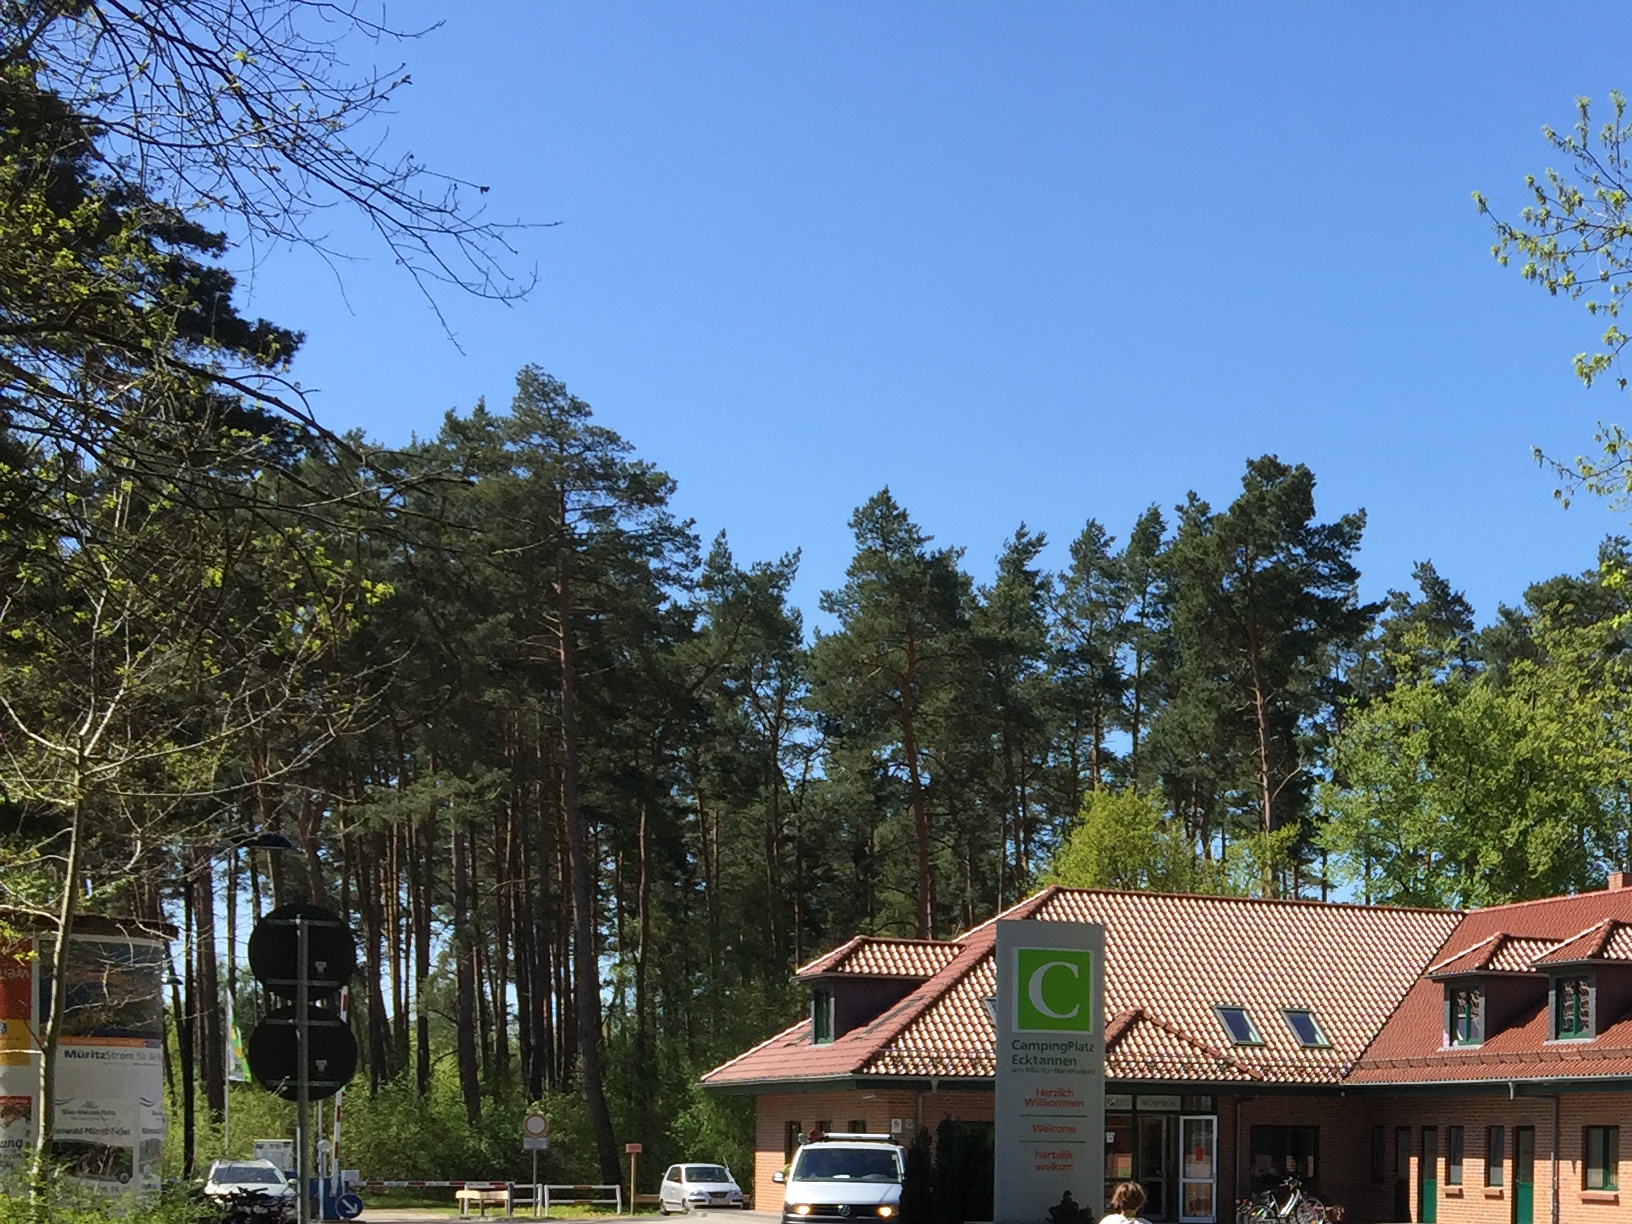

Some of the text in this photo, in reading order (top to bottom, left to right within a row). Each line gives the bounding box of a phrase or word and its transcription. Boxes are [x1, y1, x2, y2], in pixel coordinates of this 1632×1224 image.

[1027, 960, 1080, 1019] C
[1011, 1039, 1095, 1054] CampingPlatz
[64, 1049, 134, 1060] MüritzStrom
[1011, 1054, 1077, 1066] Ecktannen
[1036, 1087, 1074, 1097] Herzlich
[1023, 1097, 1085, 1108] Willkommen
[1031, 1124, 1077, 1134] Welcome
